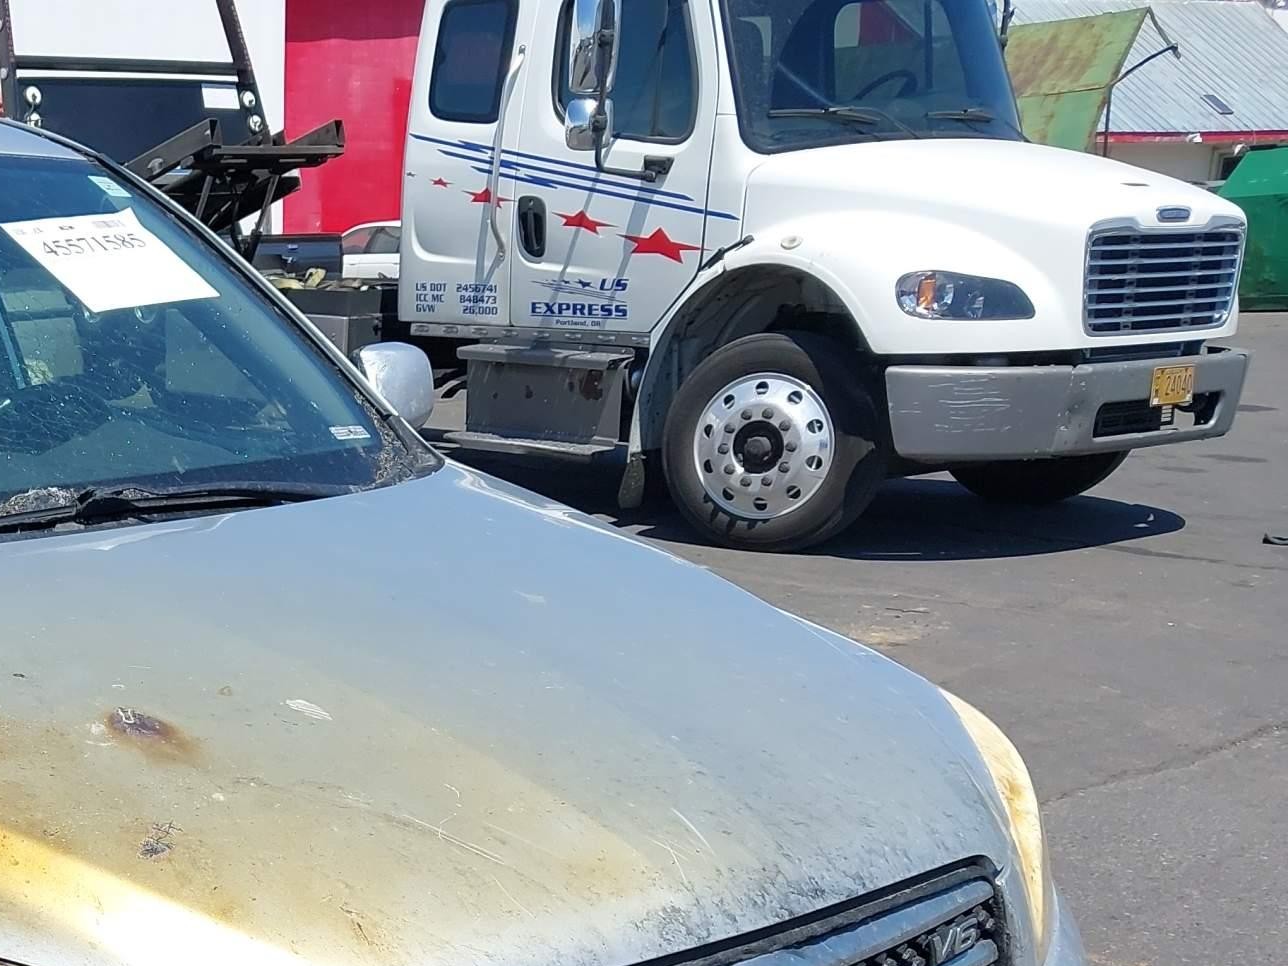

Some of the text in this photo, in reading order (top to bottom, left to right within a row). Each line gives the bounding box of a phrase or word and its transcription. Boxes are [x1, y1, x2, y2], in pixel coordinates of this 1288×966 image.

[42, 232, 147, 256] 45571585
[415, 282, 498, 293] US DOT 2456741
[599, 278, 630, 292] US
[415, 293, 497, 304] ICC MC 848473
[415, 303, 498, 316] GVW 26,000
[530, 301, 628, 317] EXPRESS
[927, 916, 979, 965] V6
